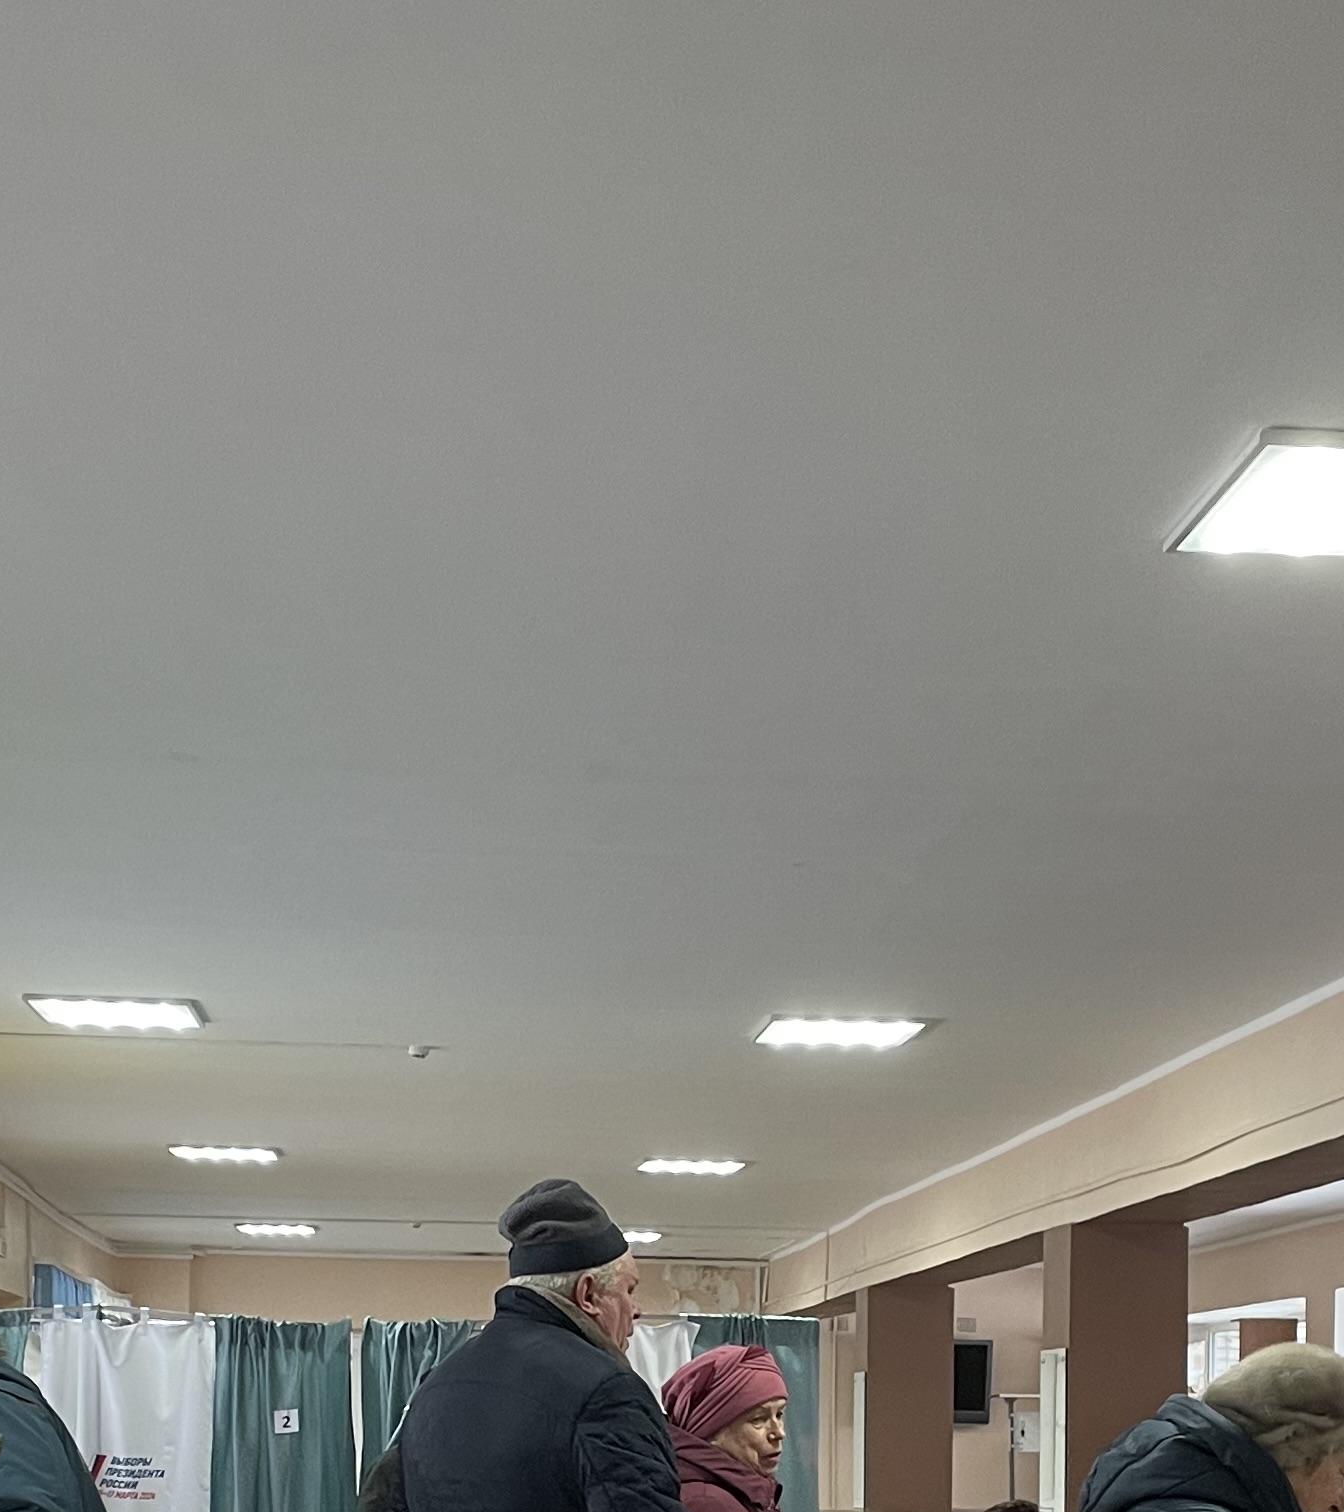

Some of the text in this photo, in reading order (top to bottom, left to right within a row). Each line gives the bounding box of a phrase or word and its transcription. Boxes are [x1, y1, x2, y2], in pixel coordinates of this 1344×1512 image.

[282, 1416, 291, 1428] 2
[110, 1456, 153, 1466] ВЫБОРЫ
[104, 1467, 165, 1479] ПРЕЗИДЕНТА
[99, 1478, 139, 1489] РОССИИ
